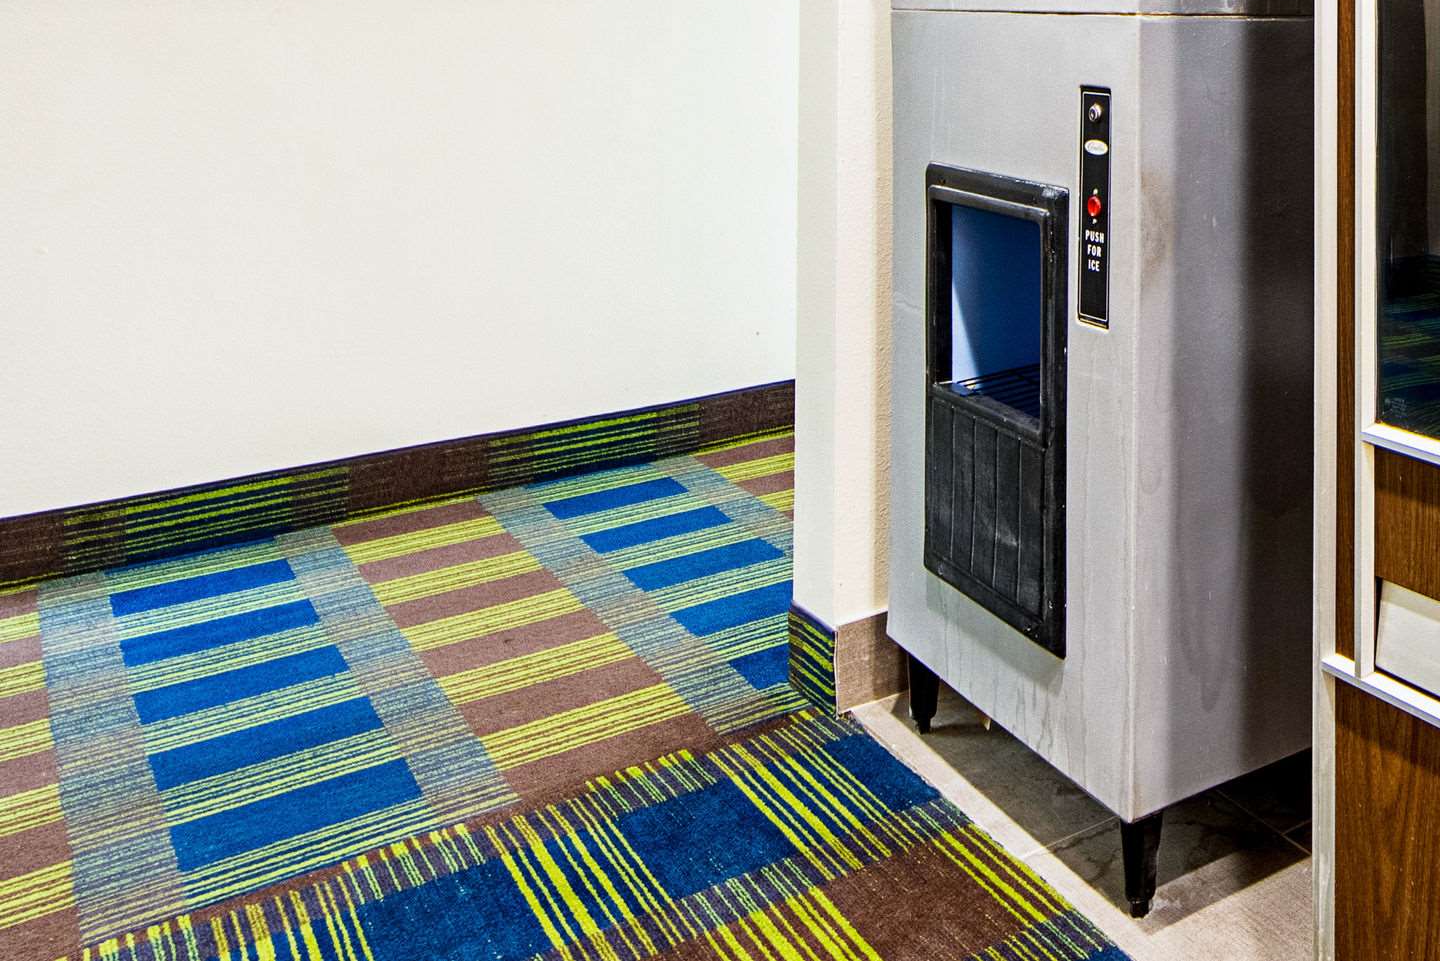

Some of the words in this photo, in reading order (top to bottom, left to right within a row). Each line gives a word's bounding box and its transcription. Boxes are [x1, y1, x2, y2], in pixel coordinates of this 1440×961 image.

[1085, 229, 1104, 243] PUSH
[1087, 244, 1101, 257] FOR
[1088, 259, 1100, 272] ICE
